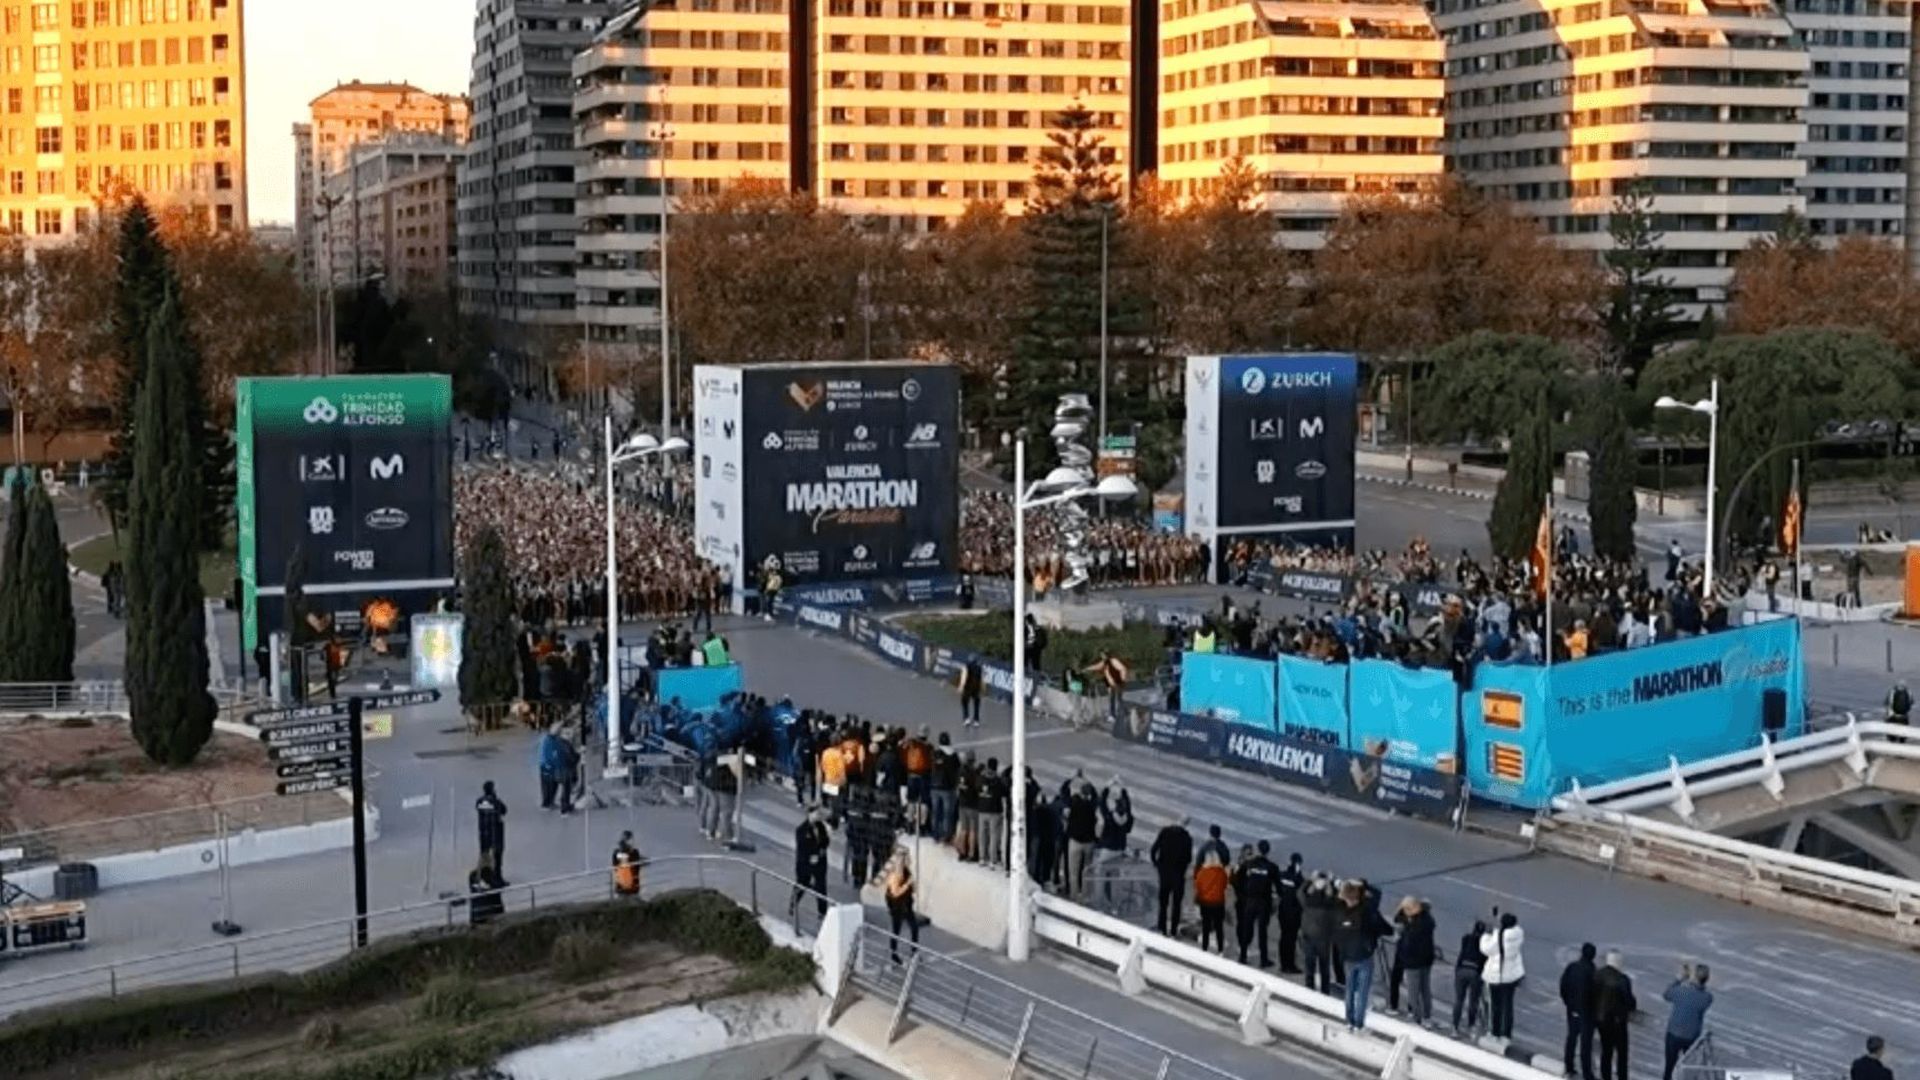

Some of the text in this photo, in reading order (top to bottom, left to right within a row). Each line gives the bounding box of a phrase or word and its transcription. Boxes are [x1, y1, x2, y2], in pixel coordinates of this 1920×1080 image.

[1271, 371, 1332, 389] ZURICH
[342, 402, 406, 414] TRINIDAD
[343, 415, 405, 425] ALFONSO
[826, 464, 881, 478] VALENCIA
[786, 479, 918, 512] MARATHON
[1560, 696, 1586, 716] This
[1591, 694, 1605, 711] is
[1607, 688, 1631, 706] the
[1634, 661, 1723, 703] MARATHON
[1228, 732, 1325, 779] #42KVALENCIA
